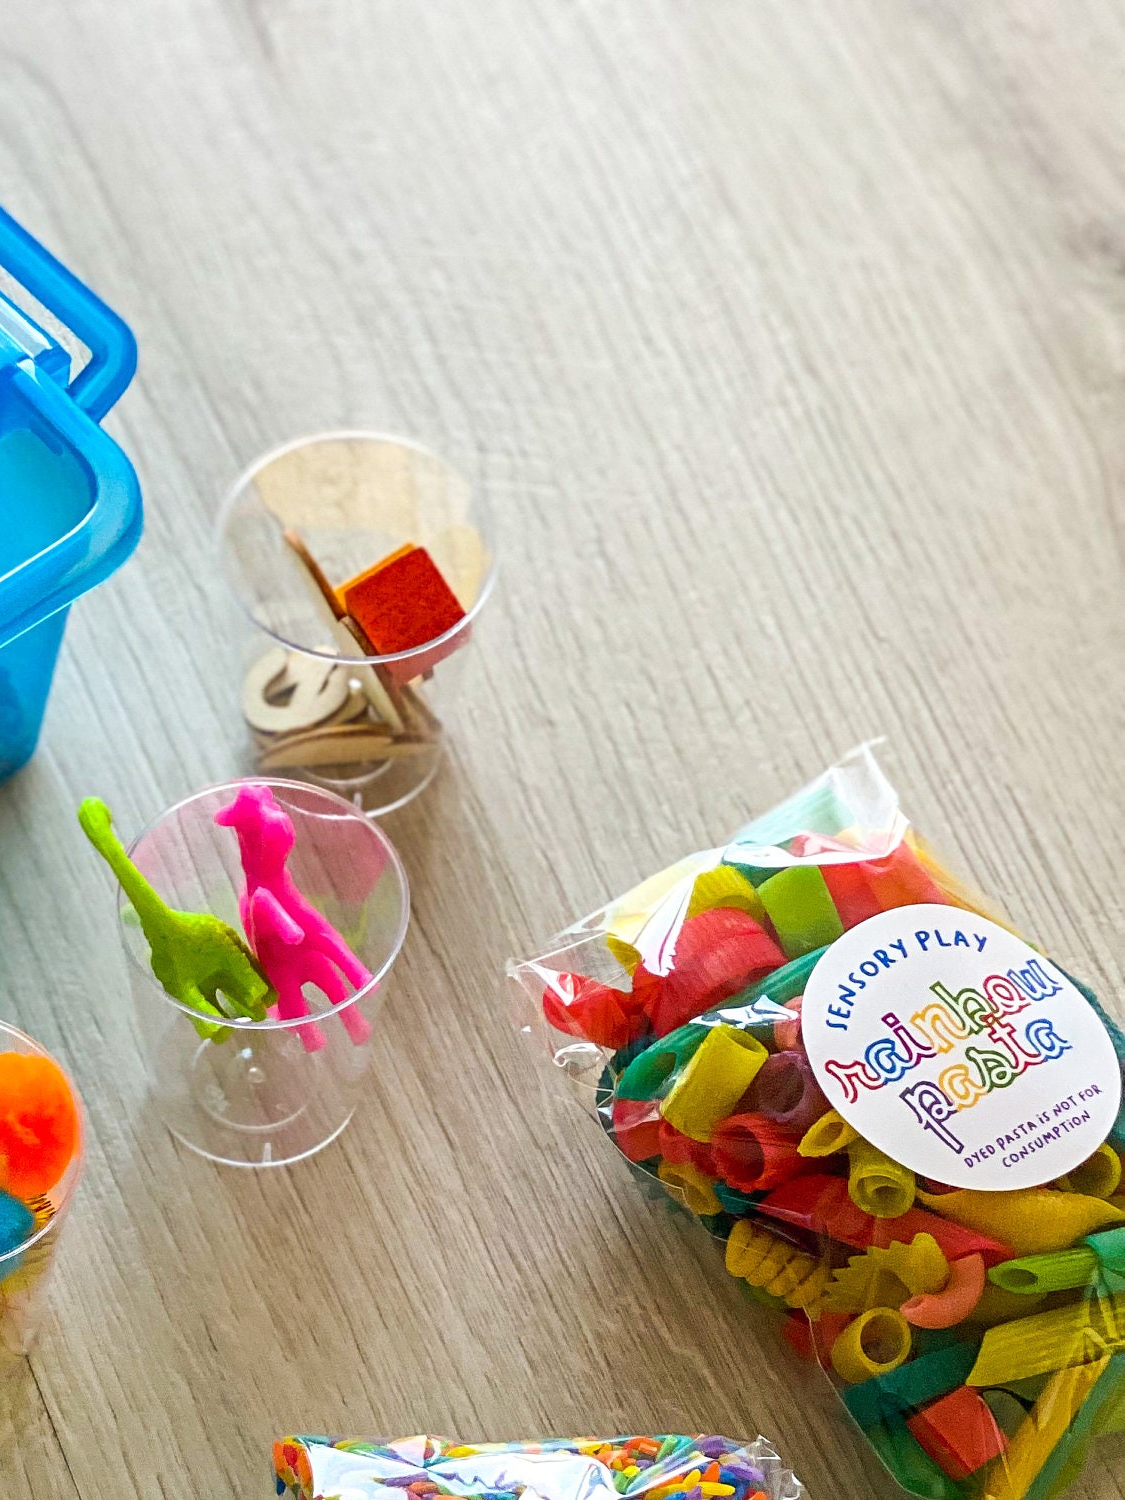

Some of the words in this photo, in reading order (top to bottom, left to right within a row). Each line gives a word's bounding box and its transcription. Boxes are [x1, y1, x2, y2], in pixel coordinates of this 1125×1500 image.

[825, 959, 1064, 1103] rainbow
[826, 939, 908, 1031] SENSORY
[915, 929, 988, 953] PLAY
[899, 1013, 1073, 1154] pasta
[964, 1143, 996, 1168] DYED
[996, 1121, 1038, 1152] PASTA
[1052, 1096, 1078, 1117] NOT
[1079, 1084, 1103, 1103] FOR
